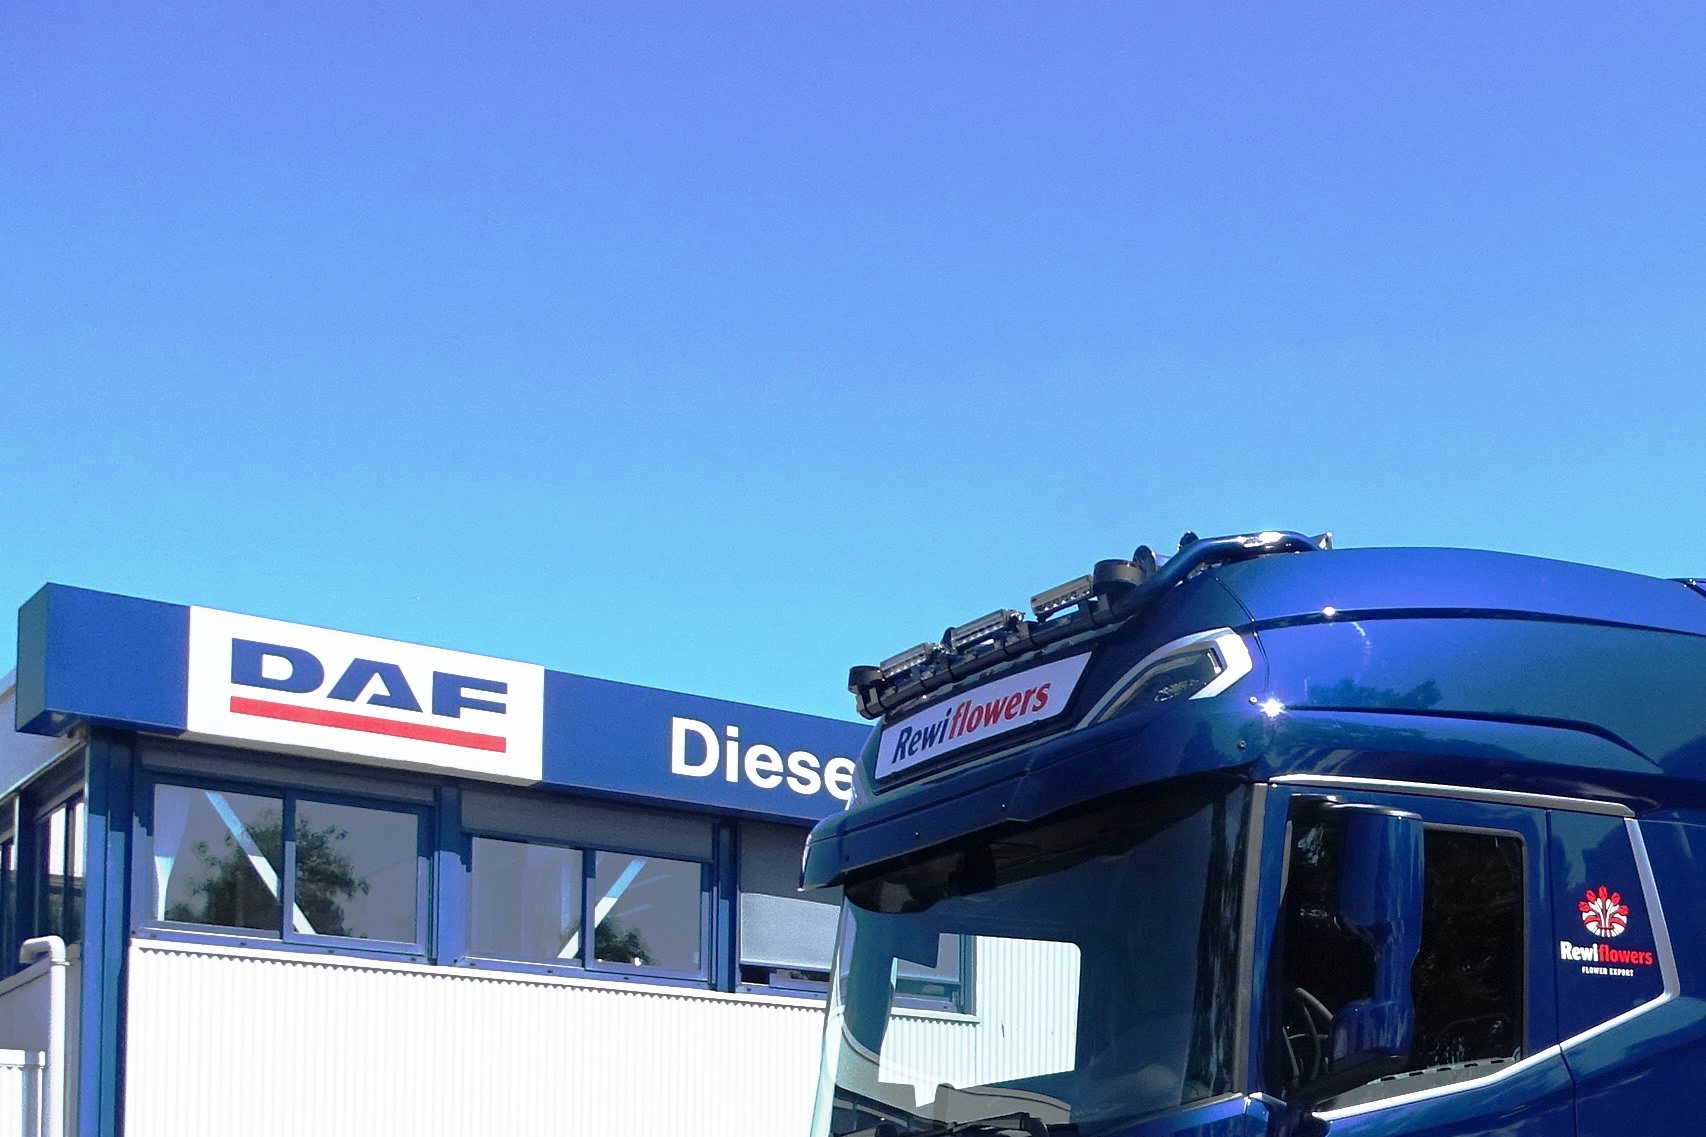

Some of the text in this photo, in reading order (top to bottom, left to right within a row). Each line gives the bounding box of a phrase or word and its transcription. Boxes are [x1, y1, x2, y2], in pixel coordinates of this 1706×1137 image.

[231, 637, 508, 719] DAF
[891, 682, 1051, 765] Rewiflowers
[1560, 940, 1654, 966] Rewiflowers
[1581, 966, 1635, 978] FLOWER EXPORT
